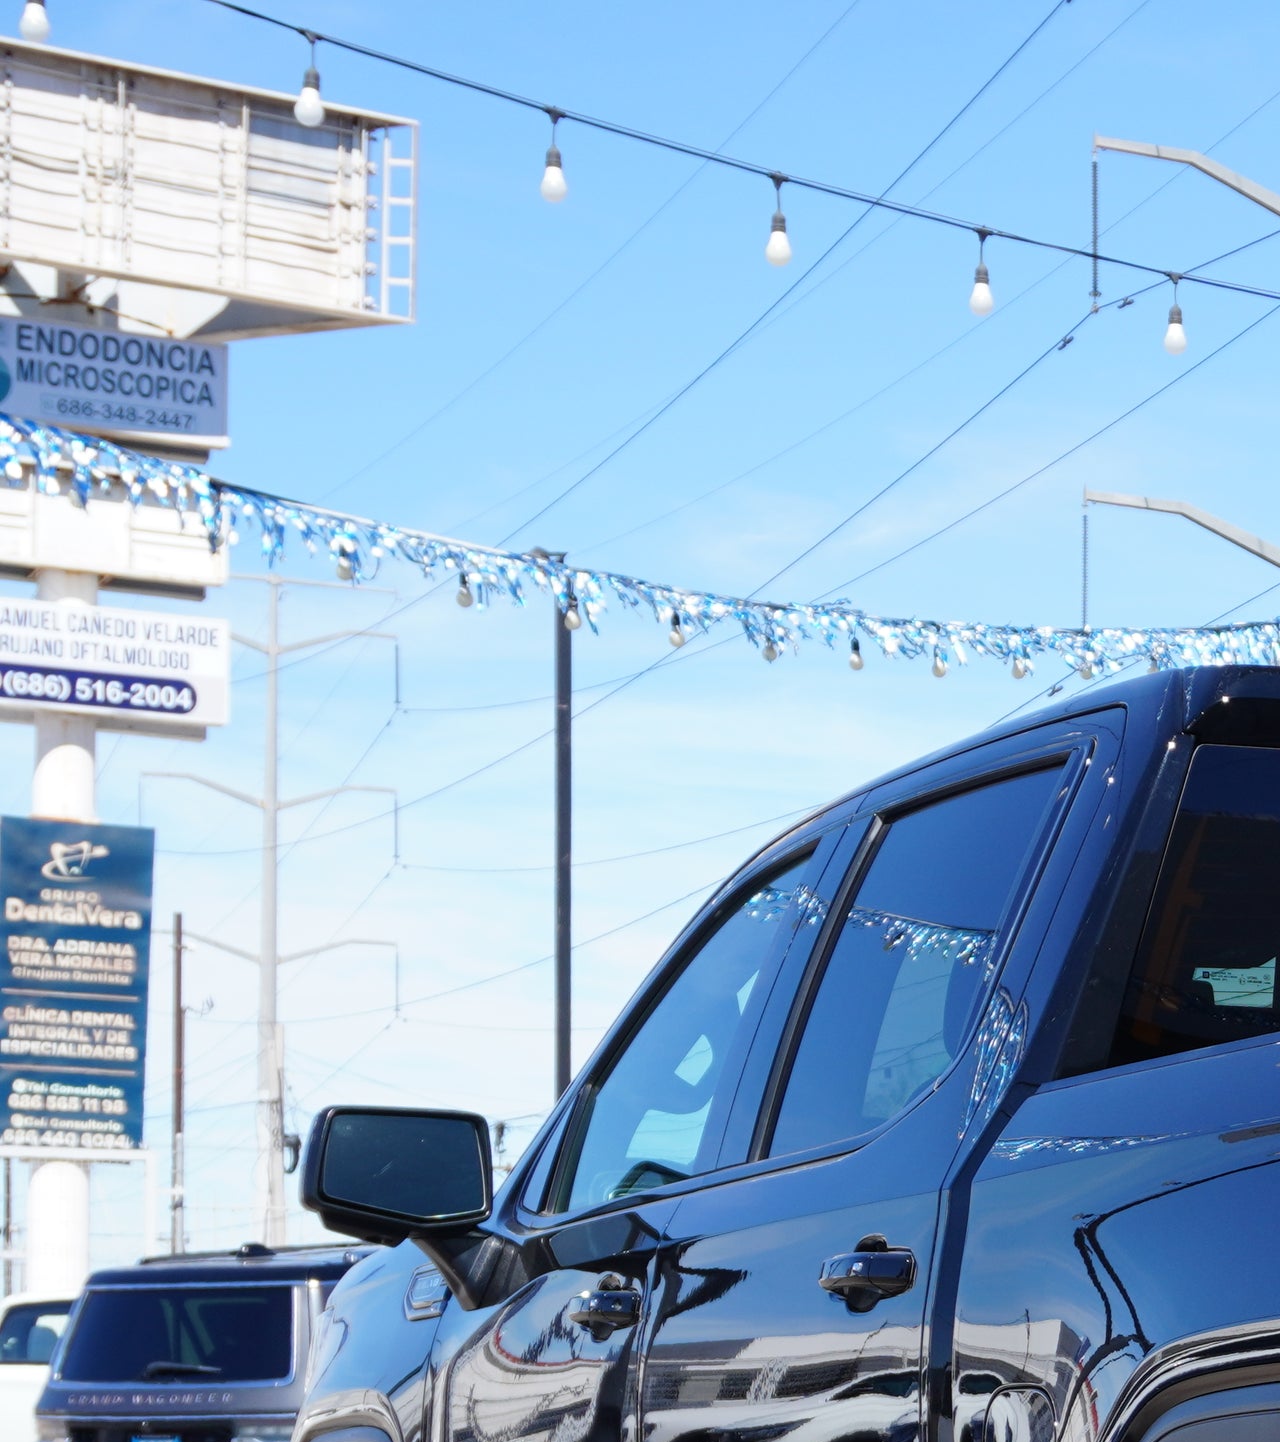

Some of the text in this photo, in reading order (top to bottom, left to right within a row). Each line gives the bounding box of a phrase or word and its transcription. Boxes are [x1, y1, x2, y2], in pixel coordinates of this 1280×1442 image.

[16, 324, 215, 376] ENDODONCIA
[16, 357, 214, 407] MICROSCOPICA
[57, 398, 193, 428] 686-348-2447
[143, 621, 219, 648] VELARDE
[3, 670, 193, 710] (686) 516-2004
[6, 898, 141, 929] DentalVera
[53, 939, 136, 957] ADRIANA
[9, 951, 136, 973] VERA MORALES
[71, 1011, 135, 1029] DENTAL
[9, 1024, 130, 1045] INTEGRAL Y DE
[1, 1039, 137, 1061] ESPECIALIDADES
[131, 1392, 232, 1404] WAGONEER
